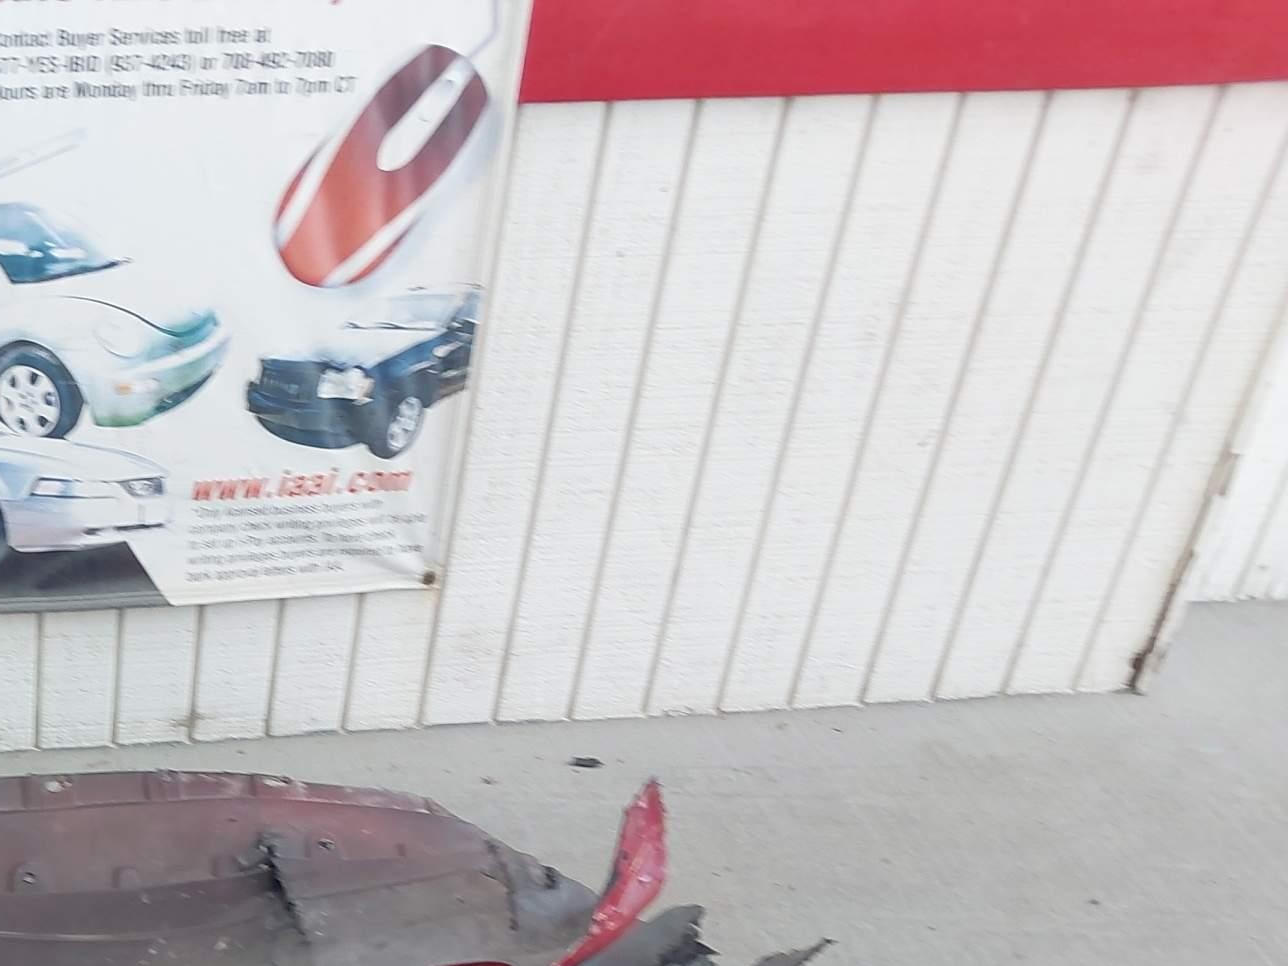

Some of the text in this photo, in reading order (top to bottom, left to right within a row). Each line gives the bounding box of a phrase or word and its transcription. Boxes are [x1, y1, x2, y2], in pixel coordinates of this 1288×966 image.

[56, 28, 104, 49] Buyer
[109, 26, 181, 46] Services
[186, 27, 208, 44] toll
[216, 26, 249, 43] free
[254, 27, 272, 43] at
[200, 56, 217, 70] or
[42, 85, 70, 99] are
[74, 81, 137, 101] Monday
[142, 80, 174, 97] thru
[179, 79, 229, 98] Friday
[236, 78, 270, 94] 7am
[274, 79, 291, 94] to
[295, 77, 330, 96] 7pm
[335, 76, 358, 93] CT
[192, 467, 413, 500] www.iaai.com
